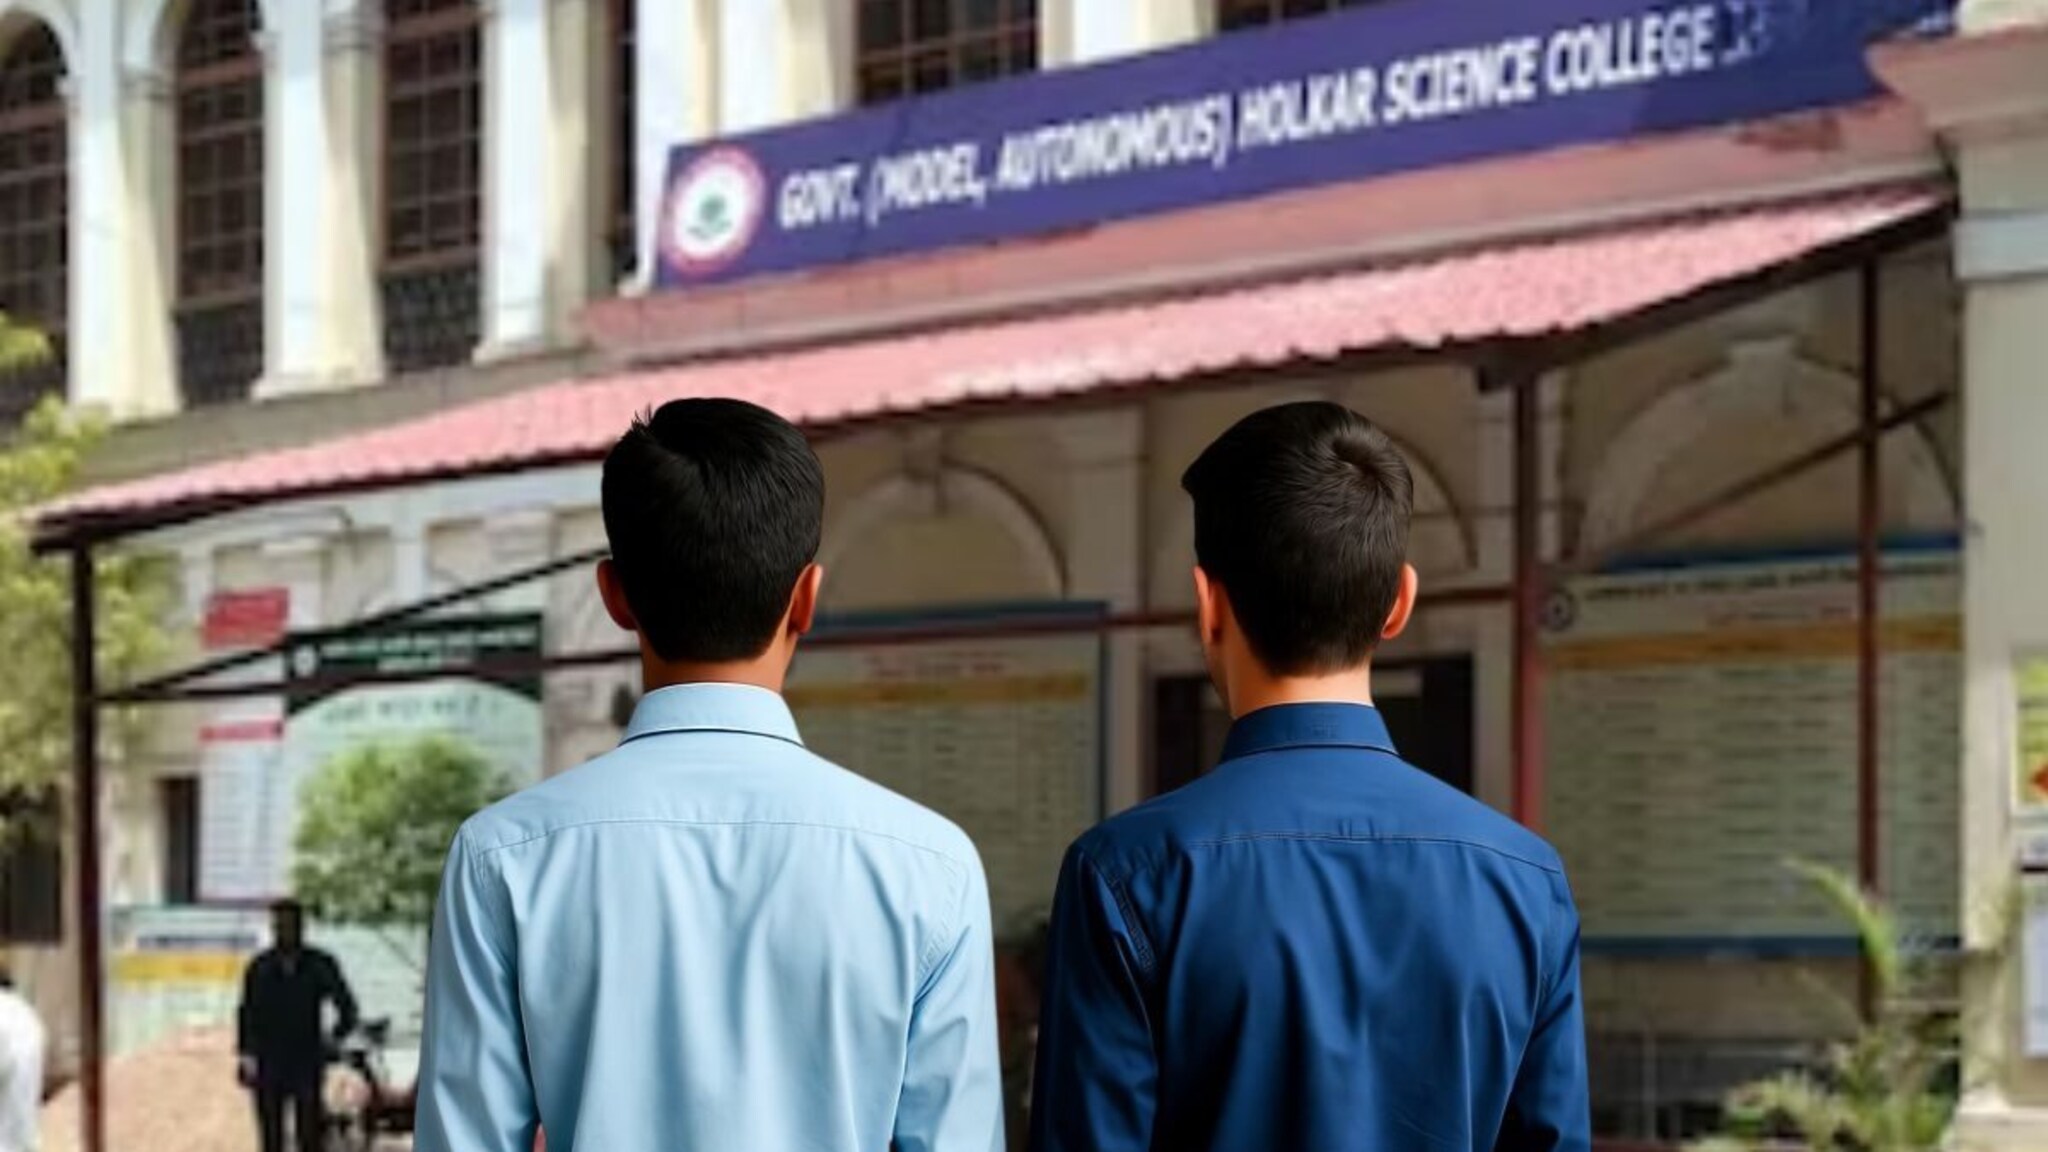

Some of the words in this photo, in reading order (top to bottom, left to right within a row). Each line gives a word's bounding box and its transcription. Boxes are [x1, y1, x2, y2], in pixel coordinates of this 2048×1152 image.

[779, 164, 860, 229] GOVT.
[997, 94, 1232, 189] AUTONOMOUS)
[1237, 67, 1376, 149] HOLKAR
[1383, 36, 1541, 122] SCIENCE
[1546, 5, 1714, 94] COLLEGE
